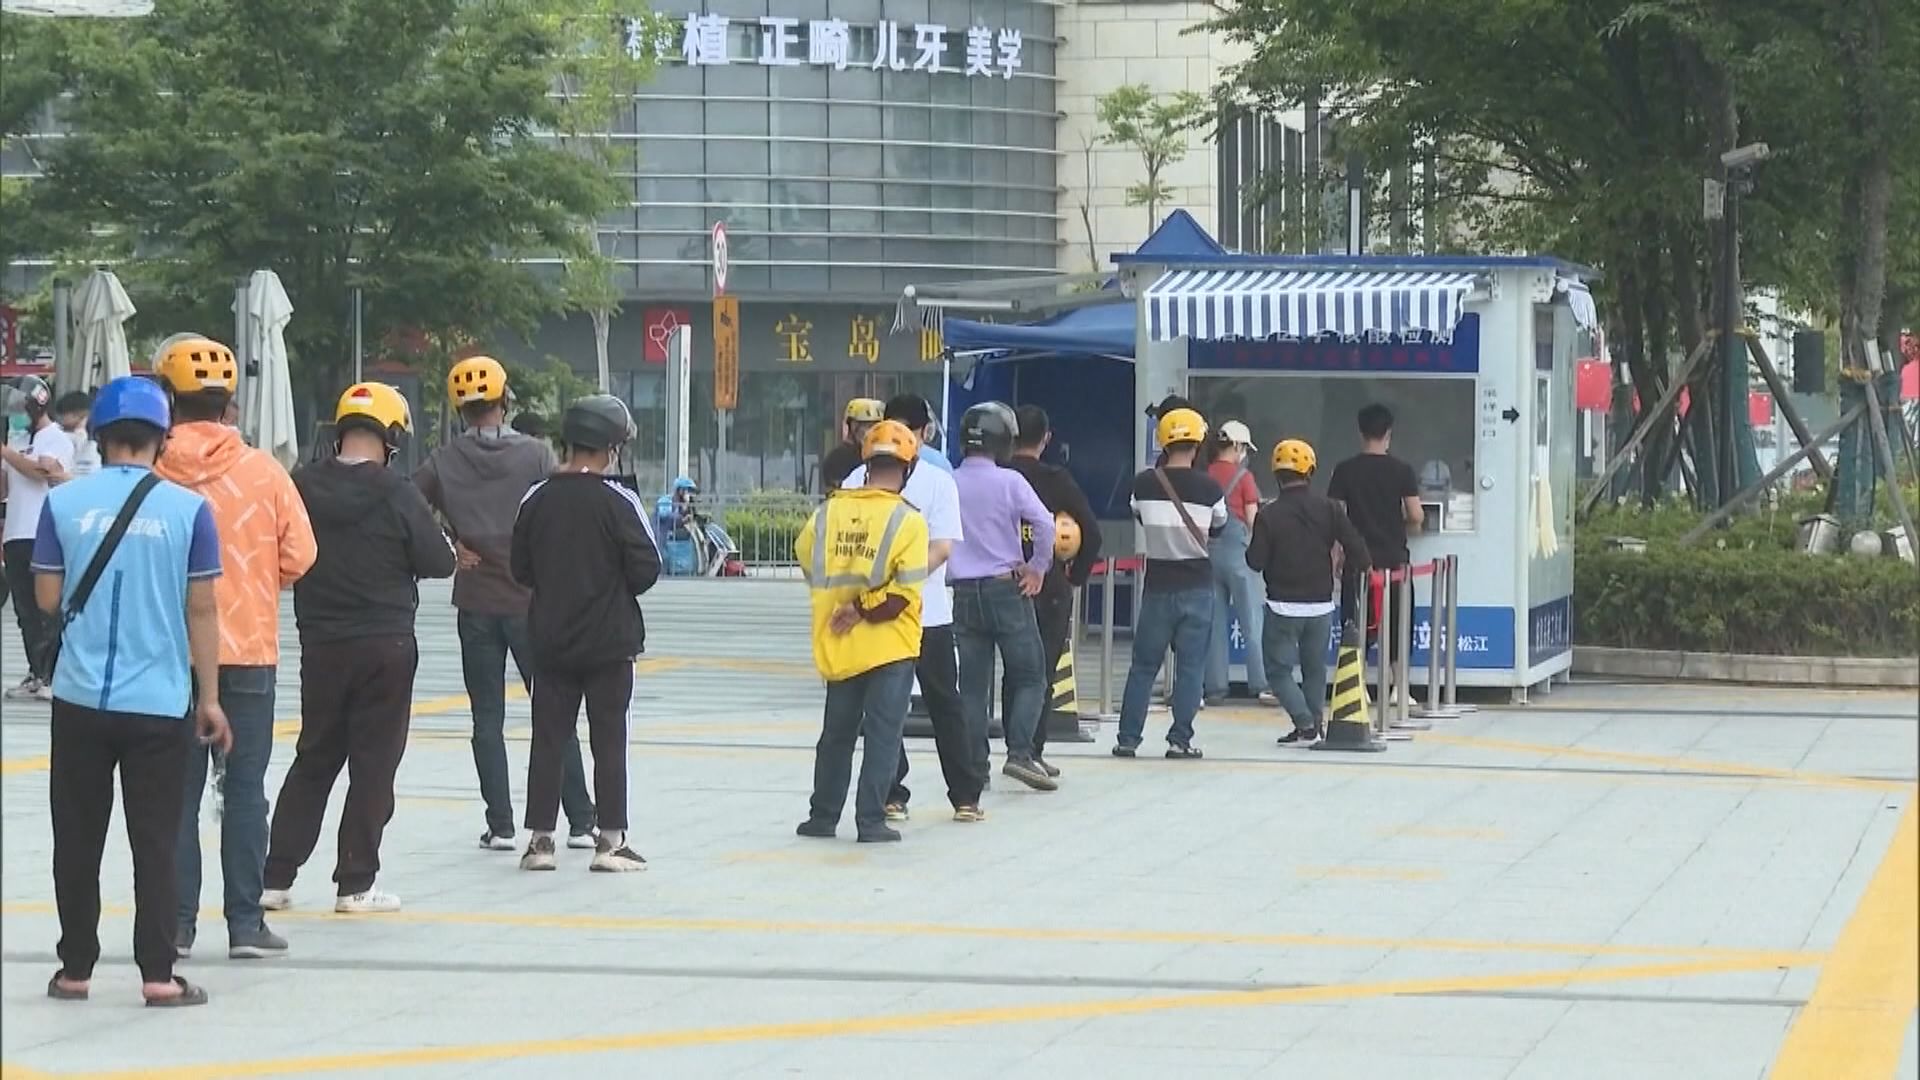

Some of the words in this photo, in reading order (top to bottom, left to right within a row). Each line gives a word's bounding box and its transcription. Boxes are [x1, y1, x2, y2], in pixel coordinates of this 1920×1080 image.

[758, 15, 848, 71] 正畸
[872, 20, 947, 73] 儿牙
[965, 26, 1022, 79] 美学
[1457, 634, 1489, 652] 松江
